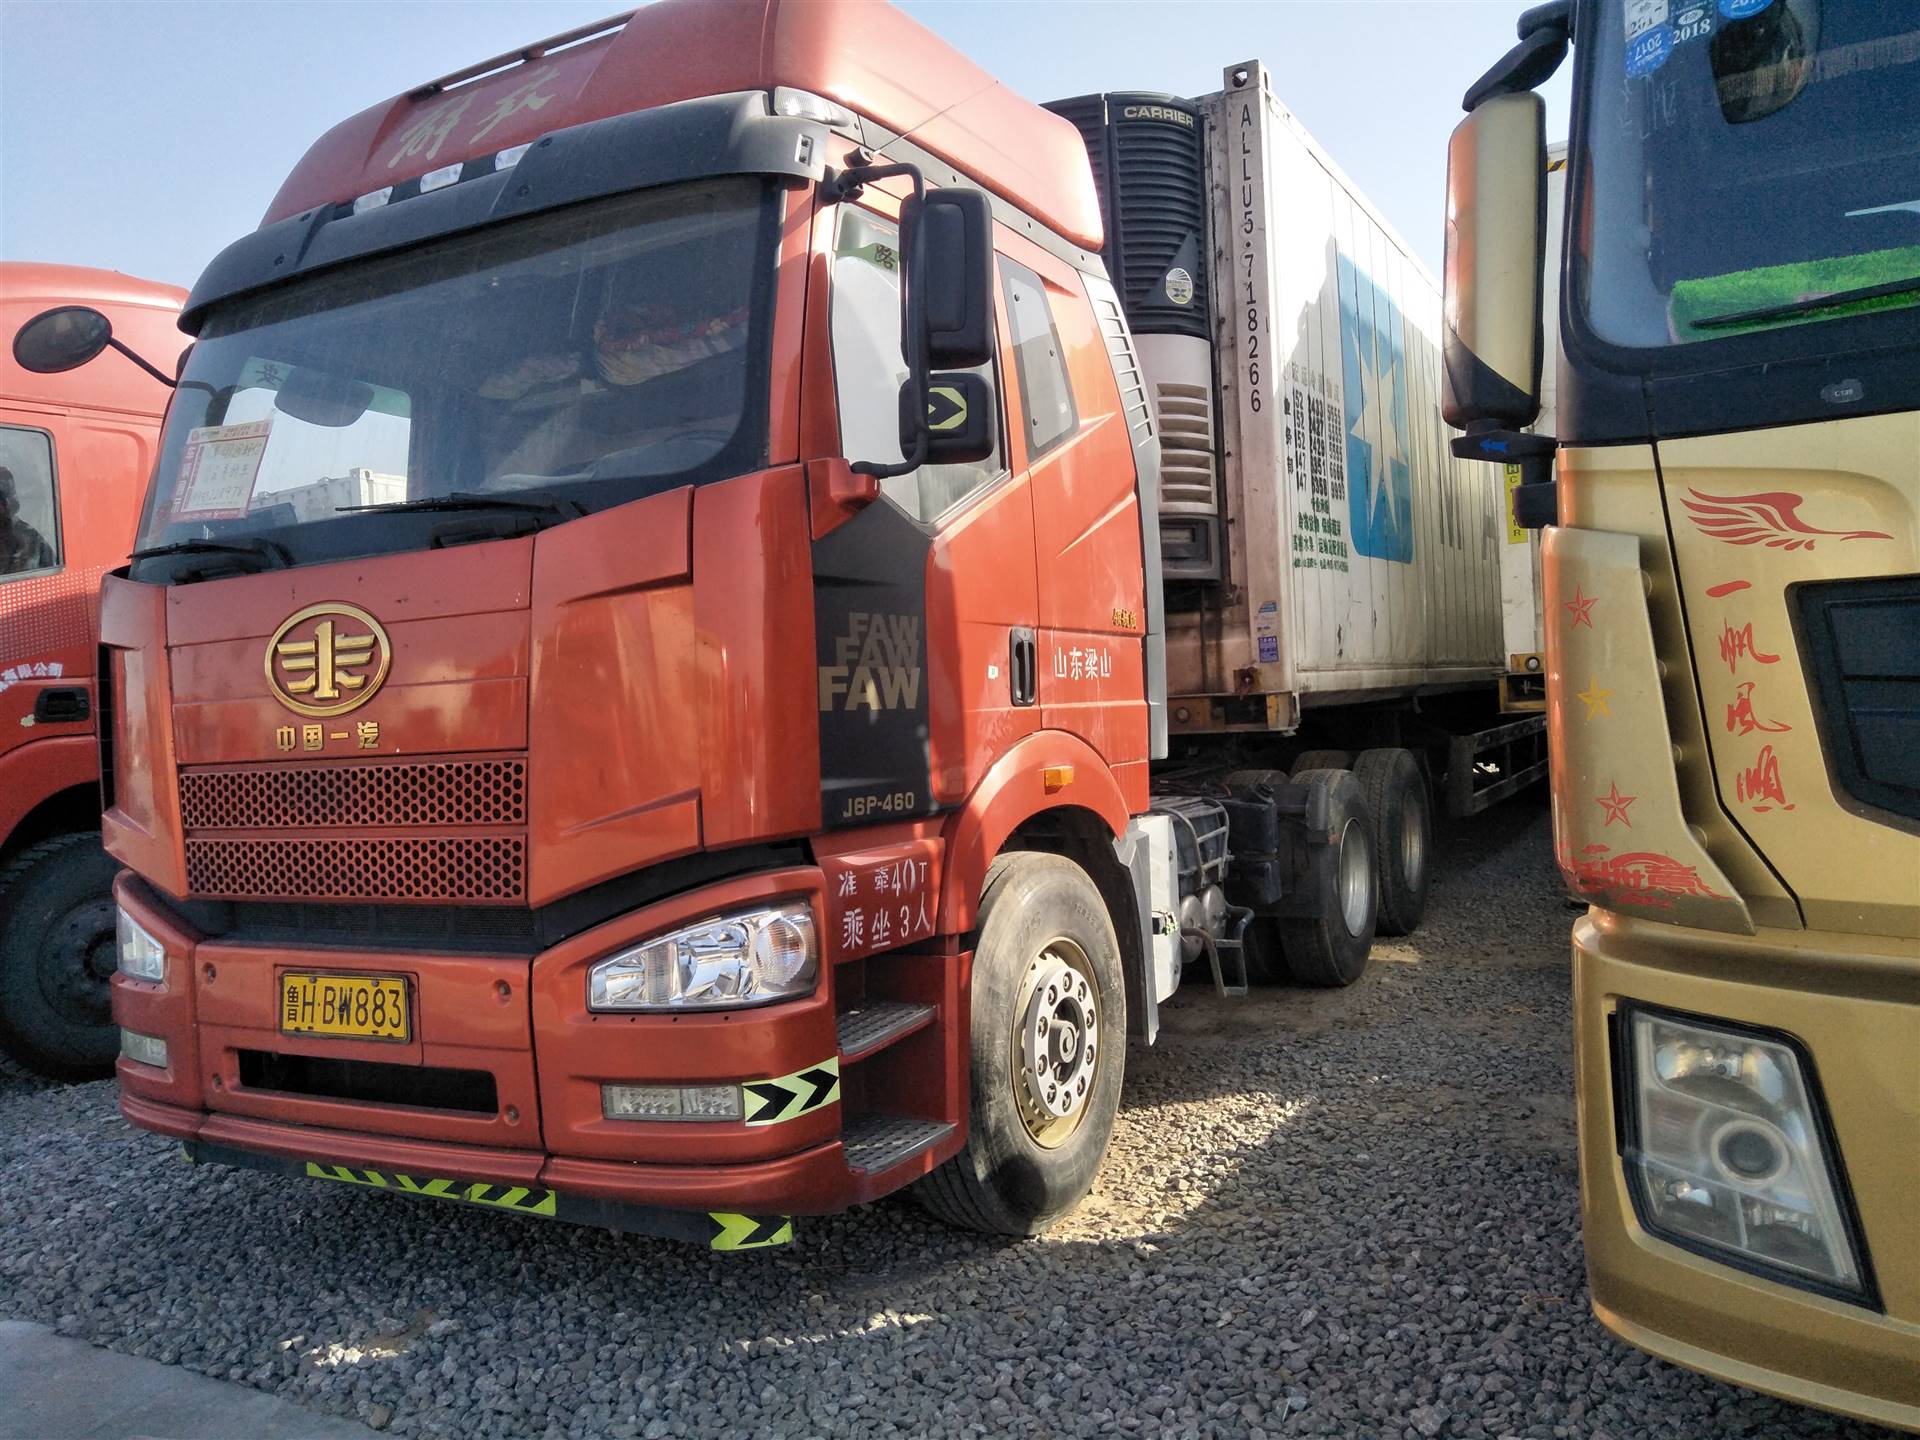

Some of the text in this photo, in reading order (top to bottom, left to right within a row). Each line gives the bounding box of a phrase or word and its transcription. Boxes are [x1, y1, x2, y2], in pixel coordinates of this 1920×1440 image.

[1672, 18, 1710, 45] 2018
[1123, 105, 1194, 128] CARRIER
[1292, 388, 1304, 411] 152
[1293, 409, 1305, 430] 152
[1294, 430, 1306, 450] 152
[848, 612, 919, 646] FAW
[836, 635, 920, 674] FAW
[1054, 646, 1111, 681] 山东梁山
[818, 665, 921, 711] FAW
[276, 721, 380, 752] 中国一汽
[842, 792, 915, 818] J6P-460
